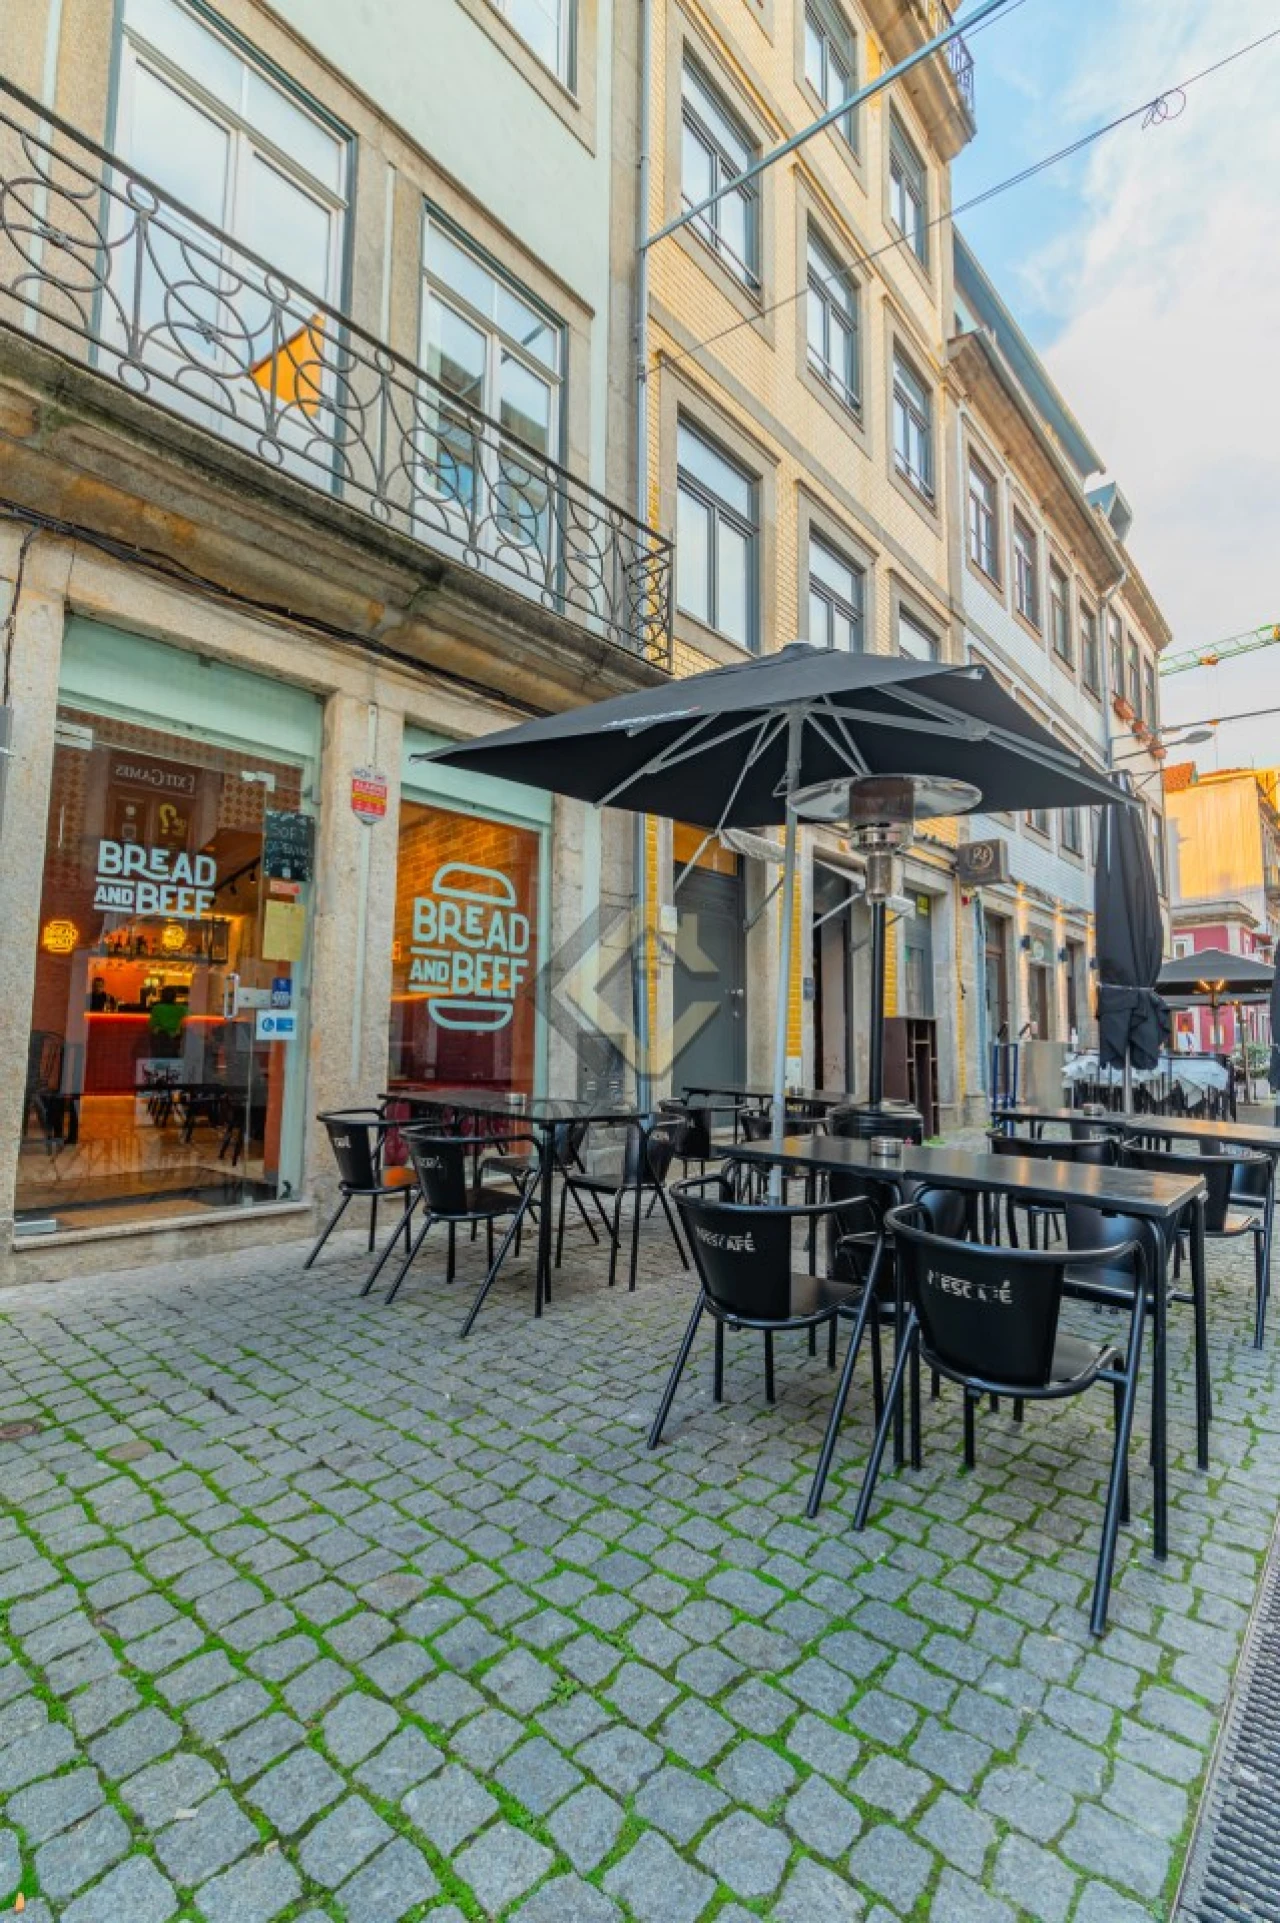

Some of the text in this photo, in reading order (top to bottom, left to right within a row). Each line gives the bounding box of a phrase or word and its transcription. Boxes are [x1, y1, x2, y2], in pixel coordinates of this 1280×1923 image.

[97, 840, 217, 887] BREAD
[94, 881, 215, 920] AND BEEF
[412, 897, 530, 954] BREAD
[409, 951, 529, 999] AND BEEF
